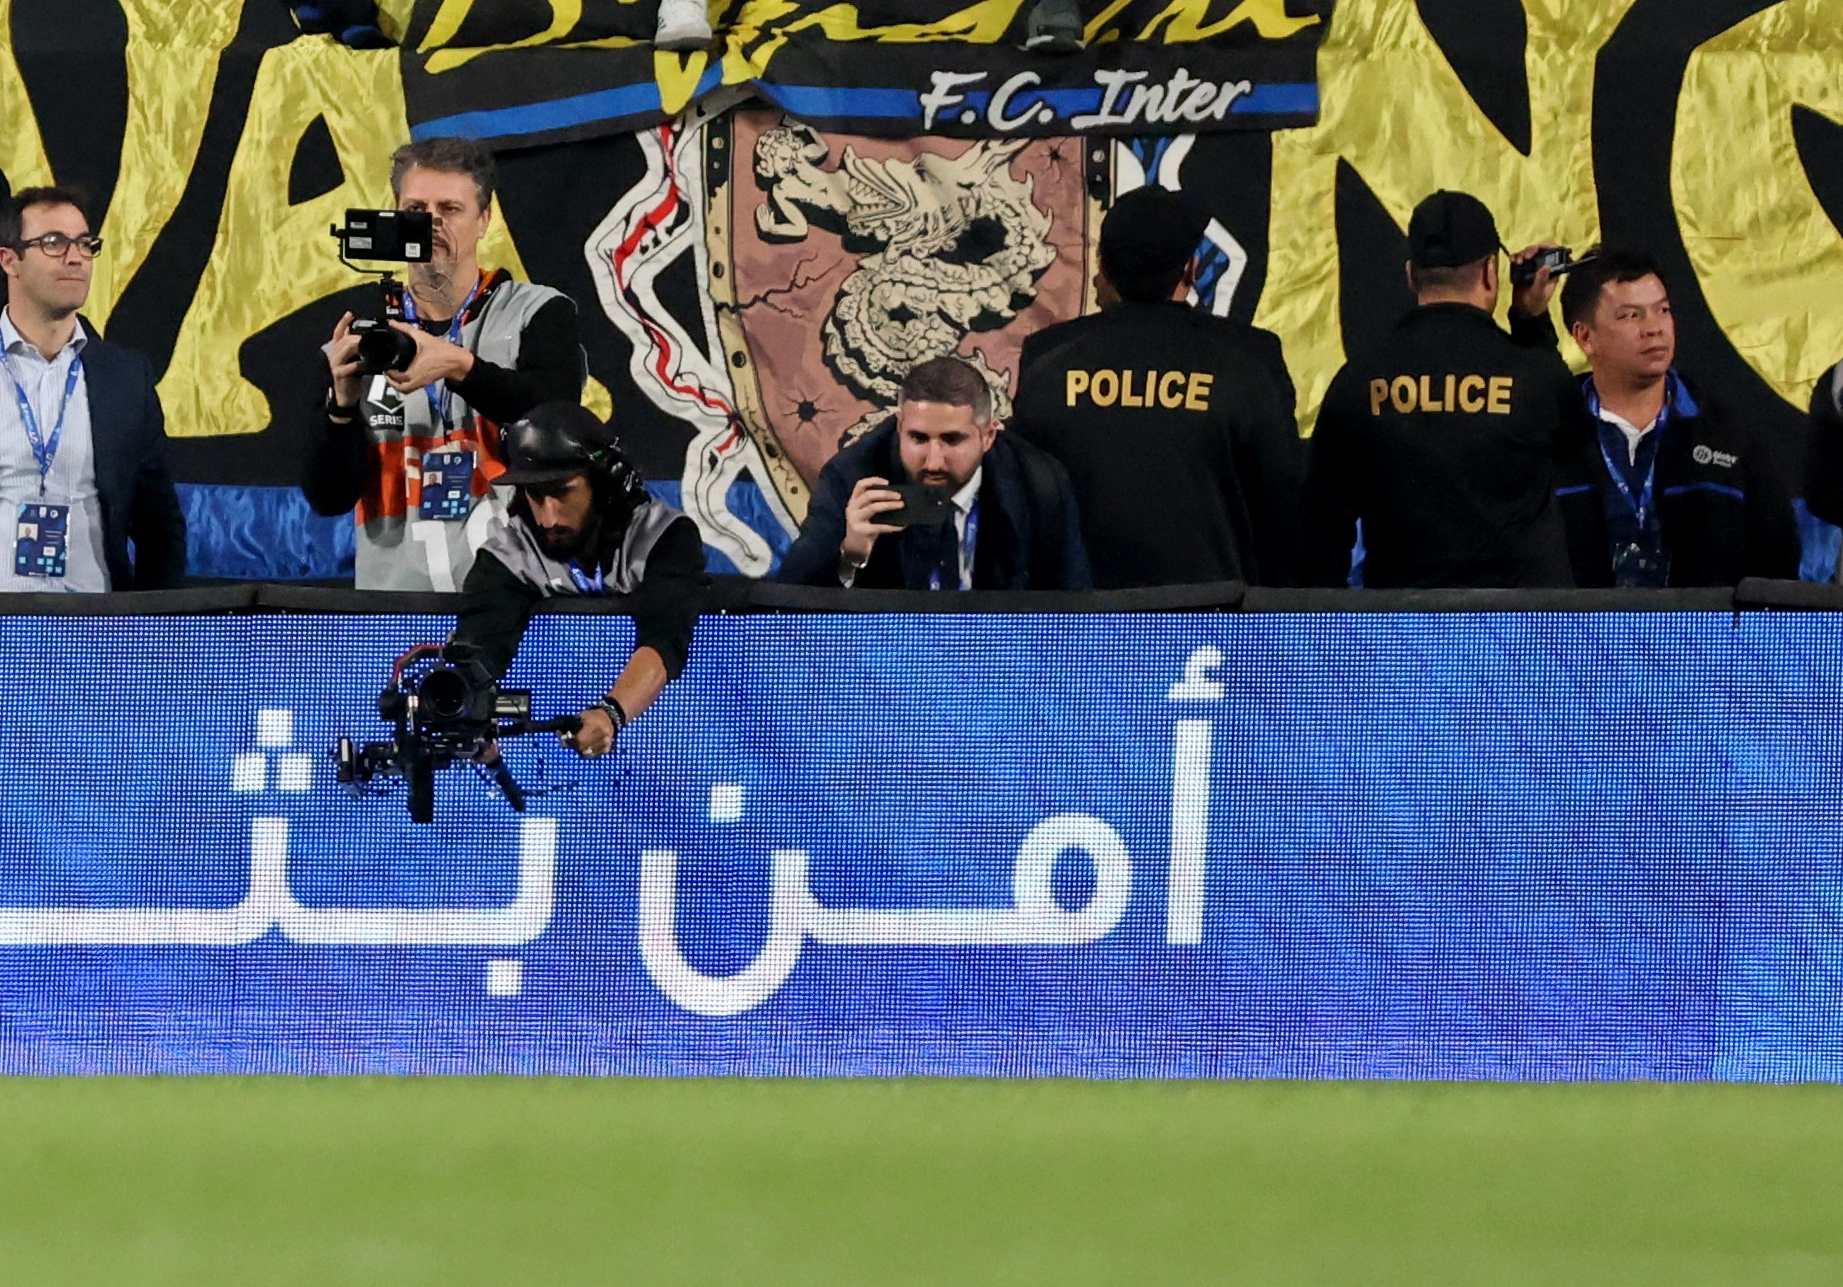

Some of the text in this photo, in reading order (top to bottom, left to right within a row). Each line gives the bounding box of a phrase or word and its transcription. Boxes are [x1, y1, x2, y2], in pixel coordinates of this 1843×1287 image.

[920, 67, 1251, 131] F.C. Inter
[1065, 369, 1214, 412] POLICE
[1369, 374, 1514, 416] POLICE
